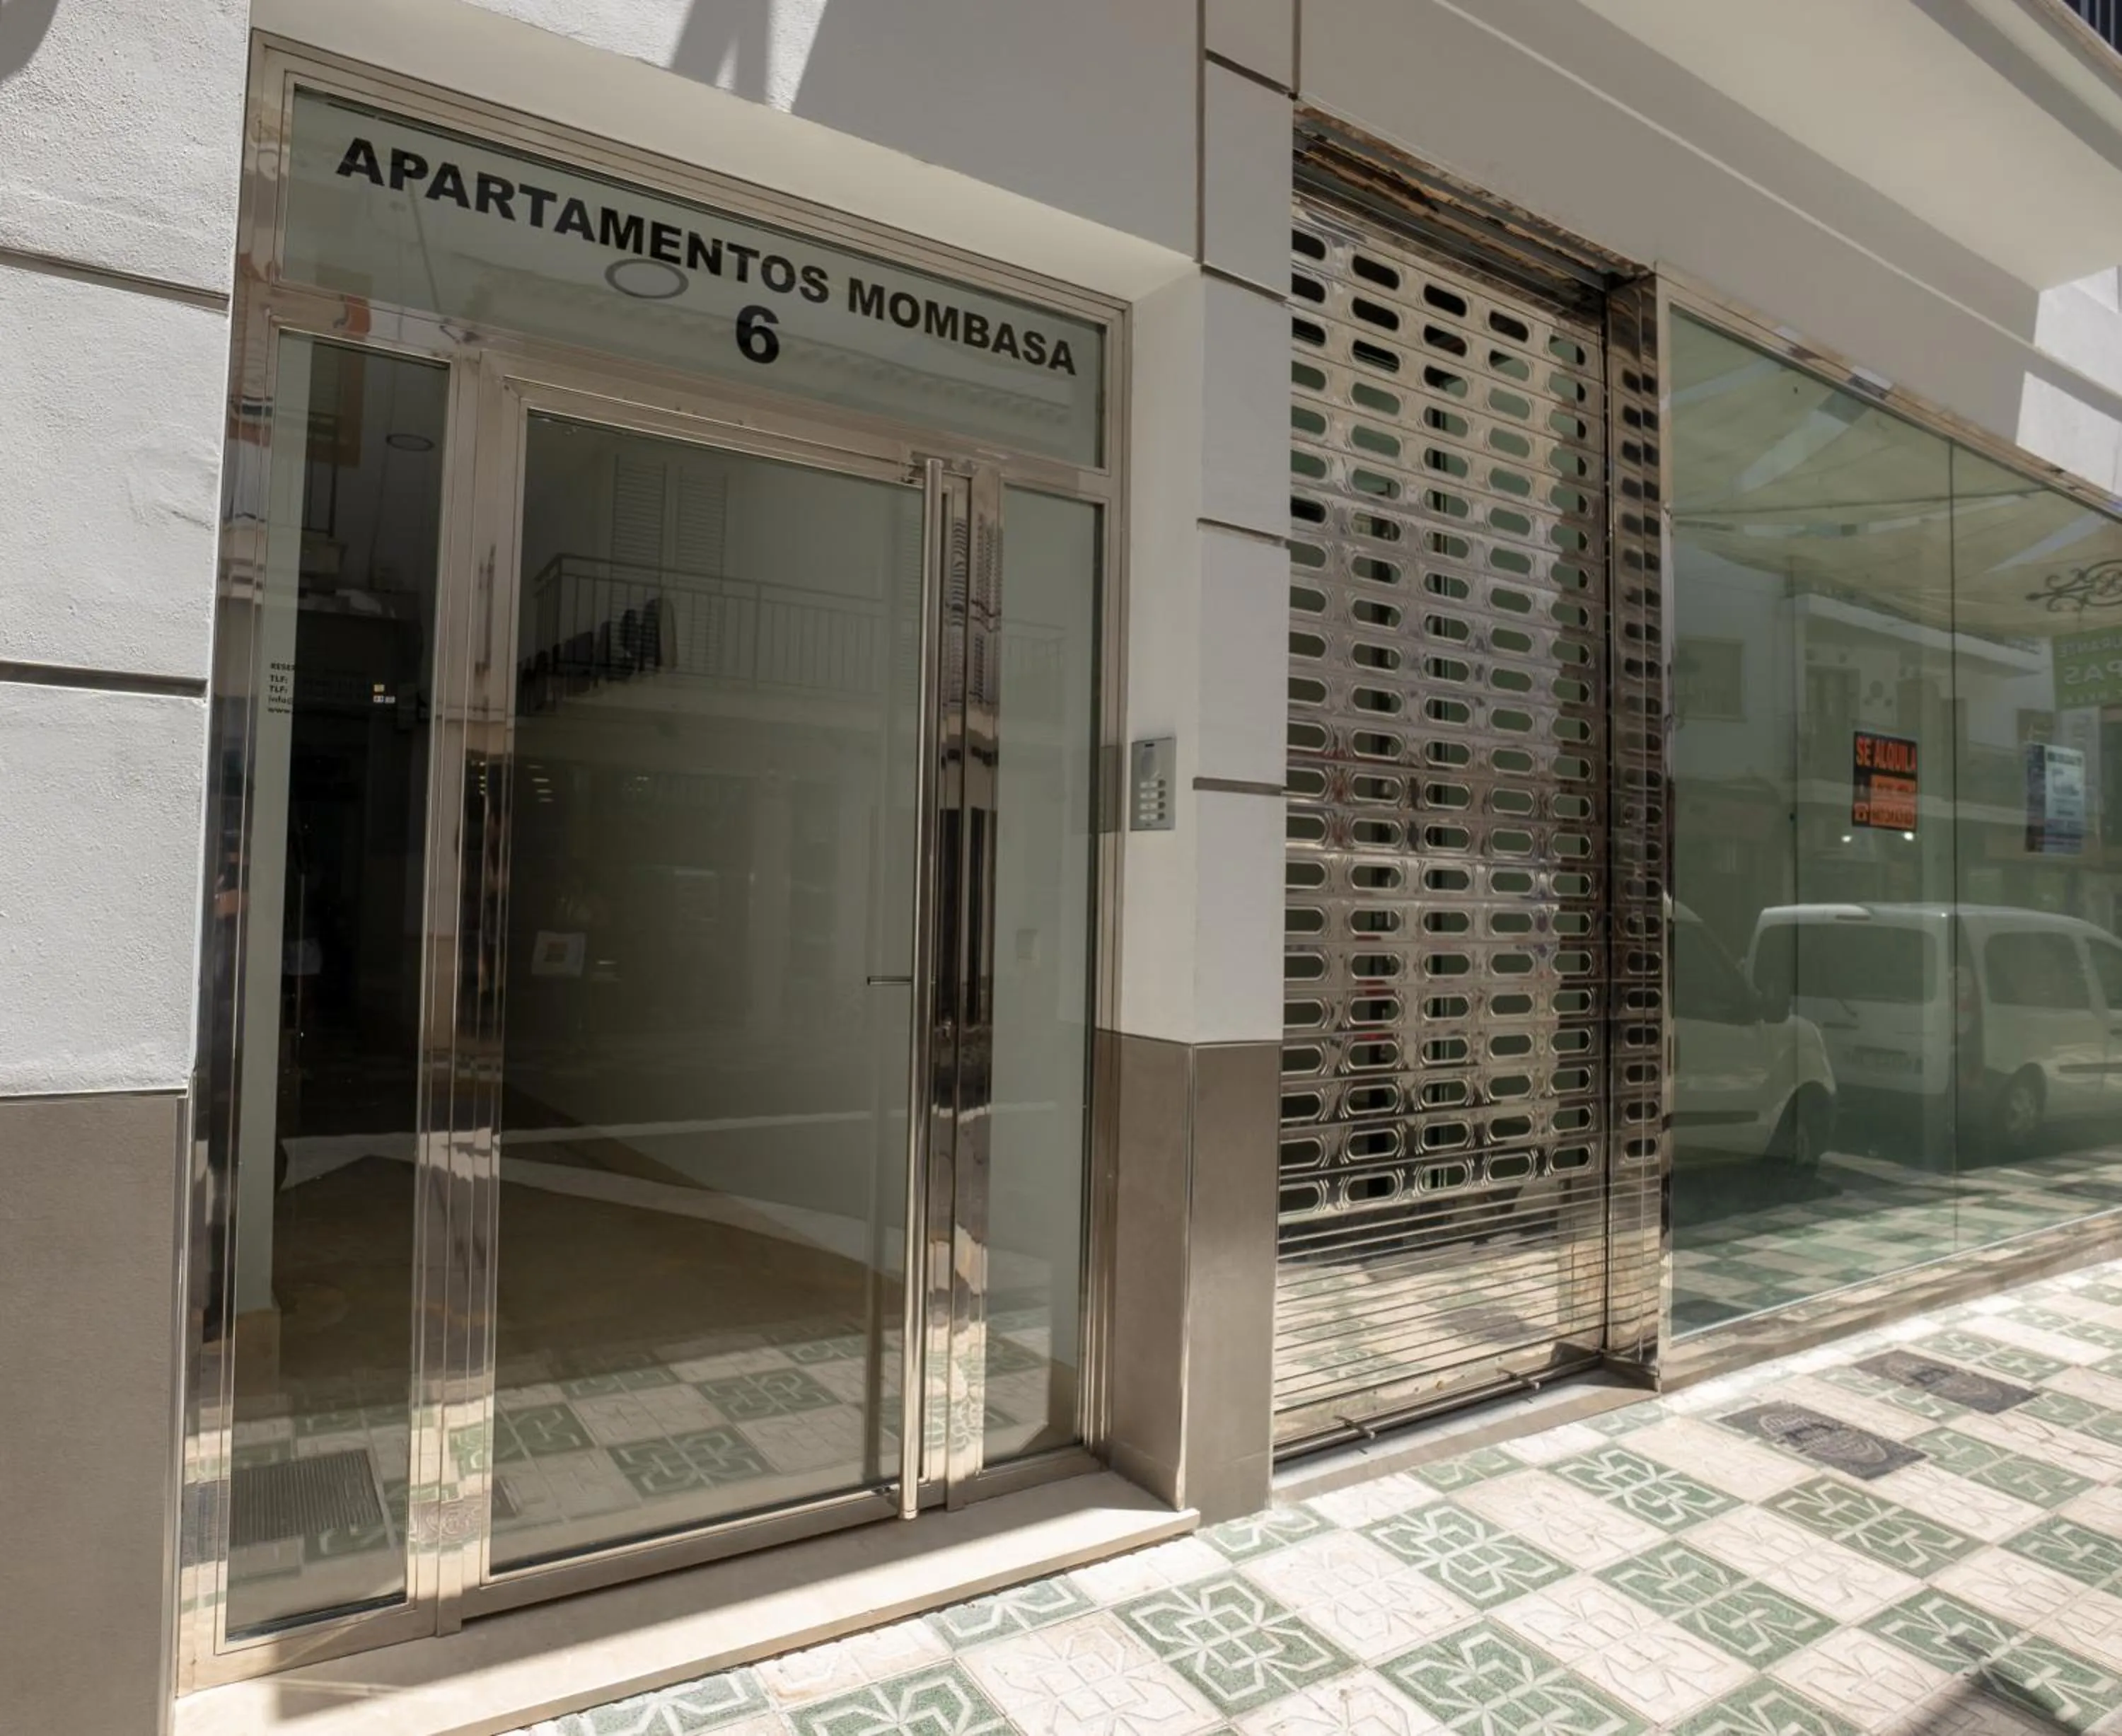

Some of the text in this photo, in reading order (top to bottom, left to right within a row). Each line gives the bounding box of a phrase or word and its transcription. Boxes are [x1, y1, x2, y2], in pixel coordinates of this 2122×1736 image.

[336, 137, 1077, 376] APARTAMENTOS MOMBASA
[735, 305, 779, 364] 6
[1855, 736, 1917, 772] SE ALQUILA
